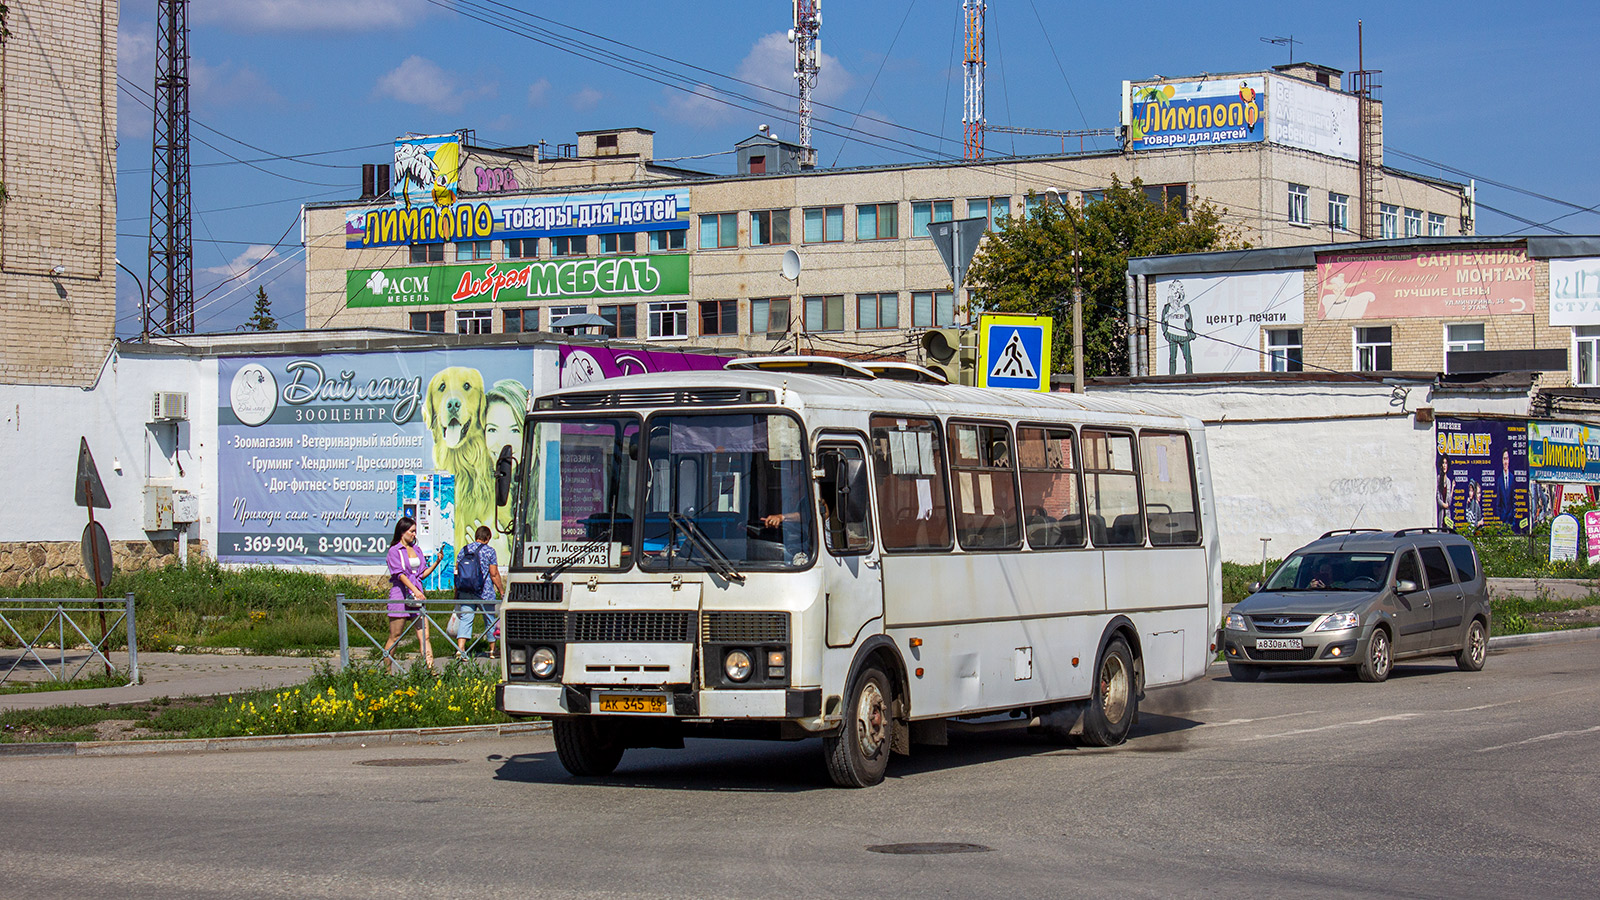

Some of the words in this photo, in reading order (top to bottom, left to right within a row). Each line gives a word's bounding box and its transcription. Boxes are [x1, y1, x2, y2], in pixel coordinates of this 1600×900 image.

[1142, 102, 1259, 133] Лимпопо
[1143, 133, 1186, 146] товары
[1188, 131, 1210, 145] для
[1212, 127, 1247, 142] детей
[502, 206, 573, 231] товары
[578, 202, 614, 228] для
[619, 193, 678, 226] детей
[1416, 249, 1533, 268] САНТЕХНИКА
[452, 263, 531, 302] Добрая
[1456, 267, 1533, 283] МОНТАЖ
[388, 275, 429, 295] АСМ
[1394, 287, 1448, 298] ЛУЧШИЕ
[1452, 286, 1492, 297] ЦЕНЫ
[388, 294, 430, 303] МЕБЕЛЬ
[1206, 314, 1243, 326] центр
[1249, 312, 1287, 323] печати
[283, 360, 358, 405] Дай
[357, 375, 422, 425] лапу
[295, 407, 386, 422] ЗООЦЕНТР
[1550, 426, 1574, 439] КНИГИ
[234, 434, 294, 449] Зоомагазин
[302, 433, 378, 451] Ветеринарный
[380, 433, 424, 448] кабинет
[1437, 432, 1492, 456] ЭЛЕГАНТ
[1542, 437, 1587, 468] Лимпопо
[252, 456, 294, 472] Груминг
[301, 455, 350, 471] Хендлинг
[356, 455, 424, 473] Дрессировка
[269, 477, 328, 494] Дог-фитнес
[333, 477, 375, 491] Беговая
[376, 479, 397, 494] дор
[232, 496, 282, 527] Приходи
[285, 510, 309, 521] сам
[320, 495, 370, 527] приводи
[373, 509, 397, 527] хозя
[1588, 526, 1600, 534] ВА
[234, 543, 241, 552] т.
[243, 536, 310, 555] 369-904,
[318, 536, 391, 553] 8-900-20-
[527, 545, 541, 564] 17
[546, 544, 560, 555] ул.
[547, 556, 586, 565] станция
[587, 554, 607, 565] УАЗ
[604, 699, 619, 710] АК
[623, 697, 645, 711] 345
[651, 697, 662, 707] 66
